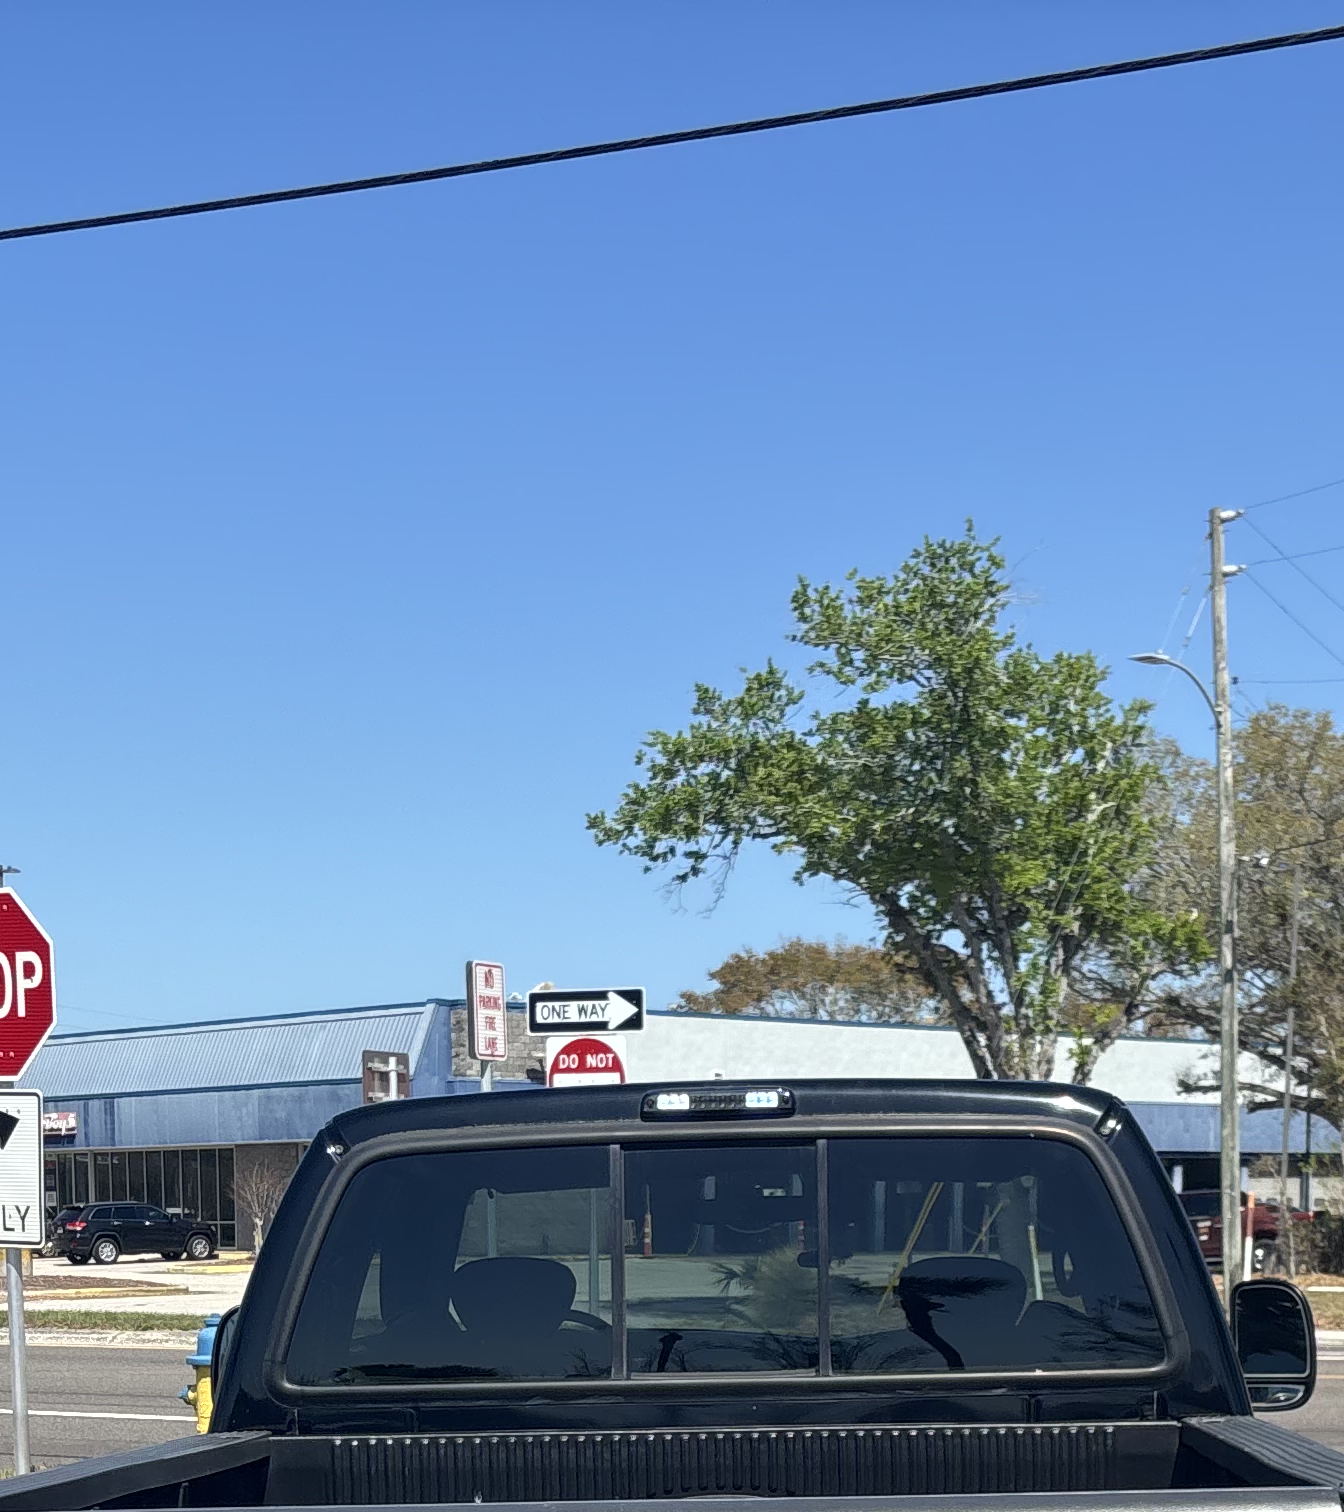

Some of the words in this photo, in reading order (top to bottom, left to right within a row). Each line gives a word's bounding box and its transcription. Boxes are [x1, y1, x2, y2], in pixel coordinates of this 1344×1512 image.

[540, 1004, 572, 1021] ONE
[577, 1003, 610, 1020] WAY
[559, 1054, 579, 1069] DO
[586, 1053, 615, 1068] NOT
